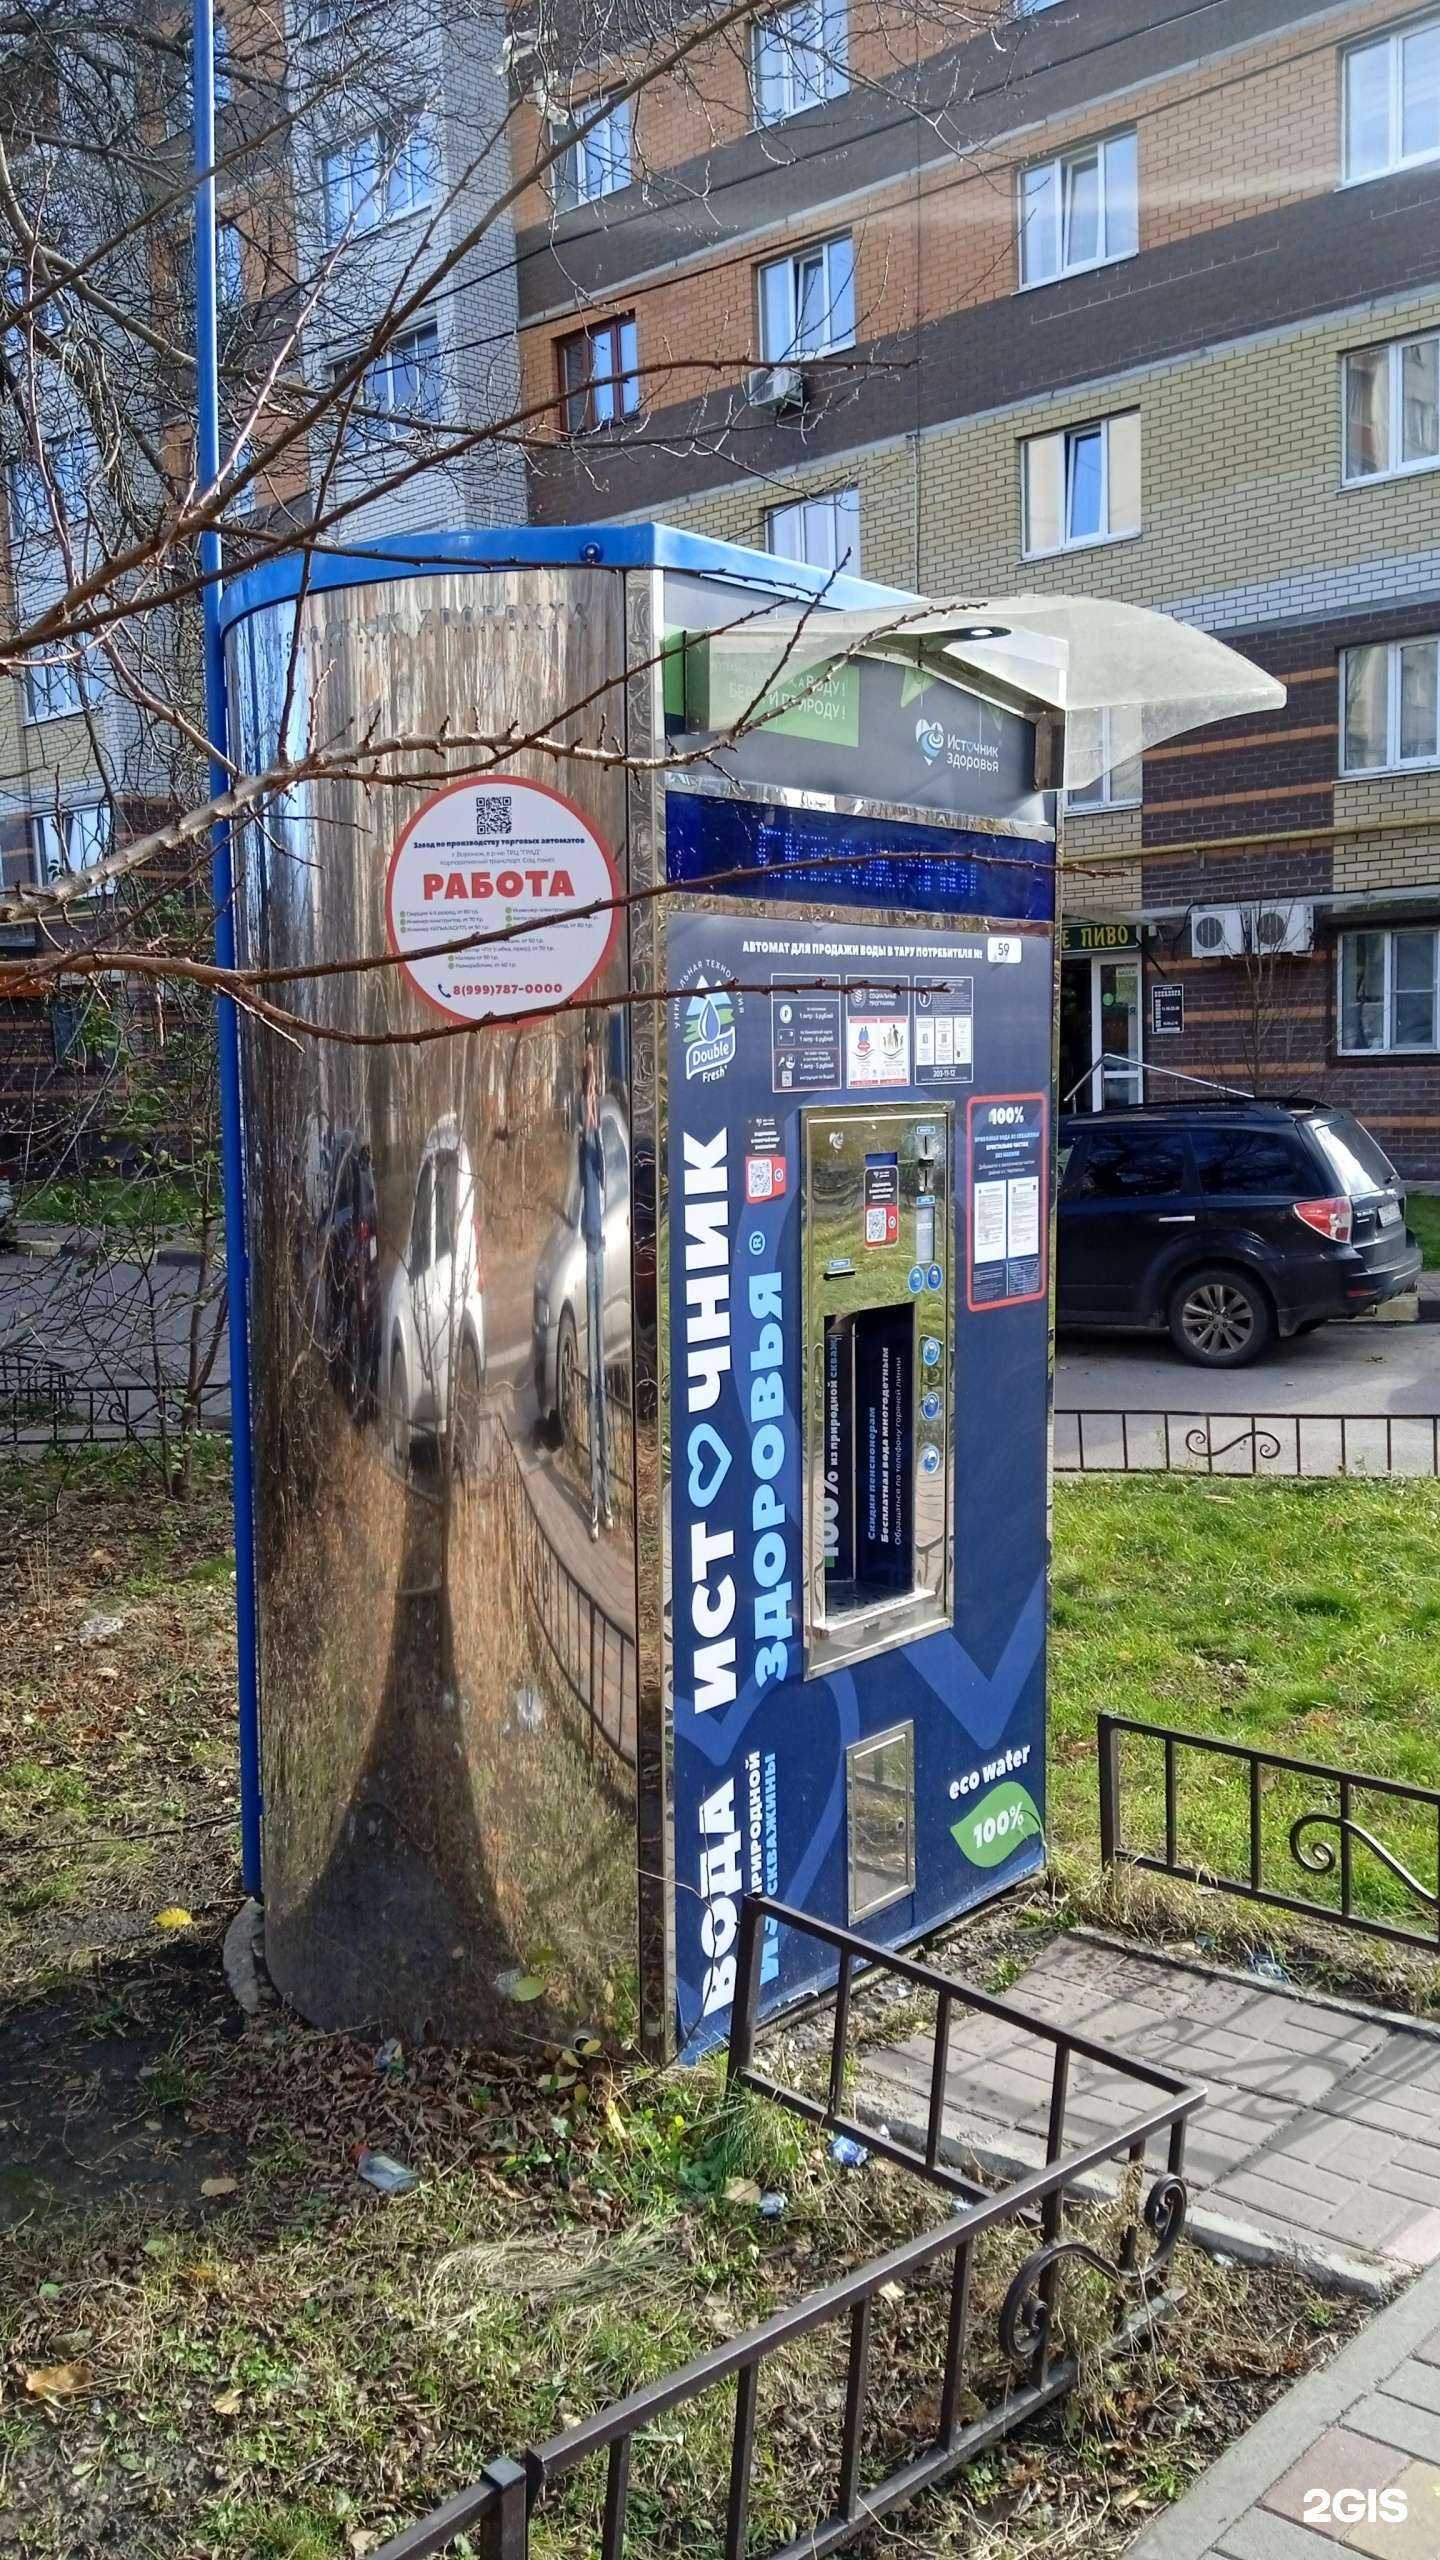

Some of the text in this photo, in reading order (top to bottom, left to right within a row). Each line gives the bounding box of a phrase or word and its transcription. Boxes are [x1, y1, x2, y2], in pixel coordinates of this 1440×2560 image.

[413, 841, 436, 849] Завод
[447, 839, 500, 849] производству
[502, 838, 540, 846] торговых
[423, 869, 575, 901] РАБОТА
[742, 940, 790, 953] АВТОМАТ
[790, 942, 811, 956] ДЛЯ
[812, 943, 858, 957] ПРОДАЖИ
[860, 944, 886, 957] ВОДЫ
[887, 946, 895, 957] В
[895, 946, 916, 958] ТАРУ
[916, 946, 973, 959] ПОТРЕБИТЕЛЯ
[998, 942, 1010, 956] 59
[1081, 925, 1129, 947] ПИВО
[453, 983, 562, 996] 8(999)787-0000
[692, 1041, 730, 1066] Double
[702, 1067, 725, 1083] Fresh
[989, 1106, 1025, 1125] 100%
[893, 1356, 902, 1387] линии
[827, 1380, 841, 1450] природной
[893, 1389, 903, 1427] горячей
[830, 1451, 838, 1466] из
[880, 1347, 890, 1543] Бесплатная вода многодетным
[893, 1428, 903, 1473] телефону
[748, 1271, 788, 1690] ЗДОРОВЬЯ
[867, 1406, 878, 1540] Скидки пенсионерам
[893, 1483, 902, 1546] Обращаться
[949, 1745, 1031, 1800] eco water
[764, 1753, 778, 1896] СКВАЖИНЫ
[972, 1801, 1025, 1848] 100%
[699, 1777, 743, 2017] ВОДА
